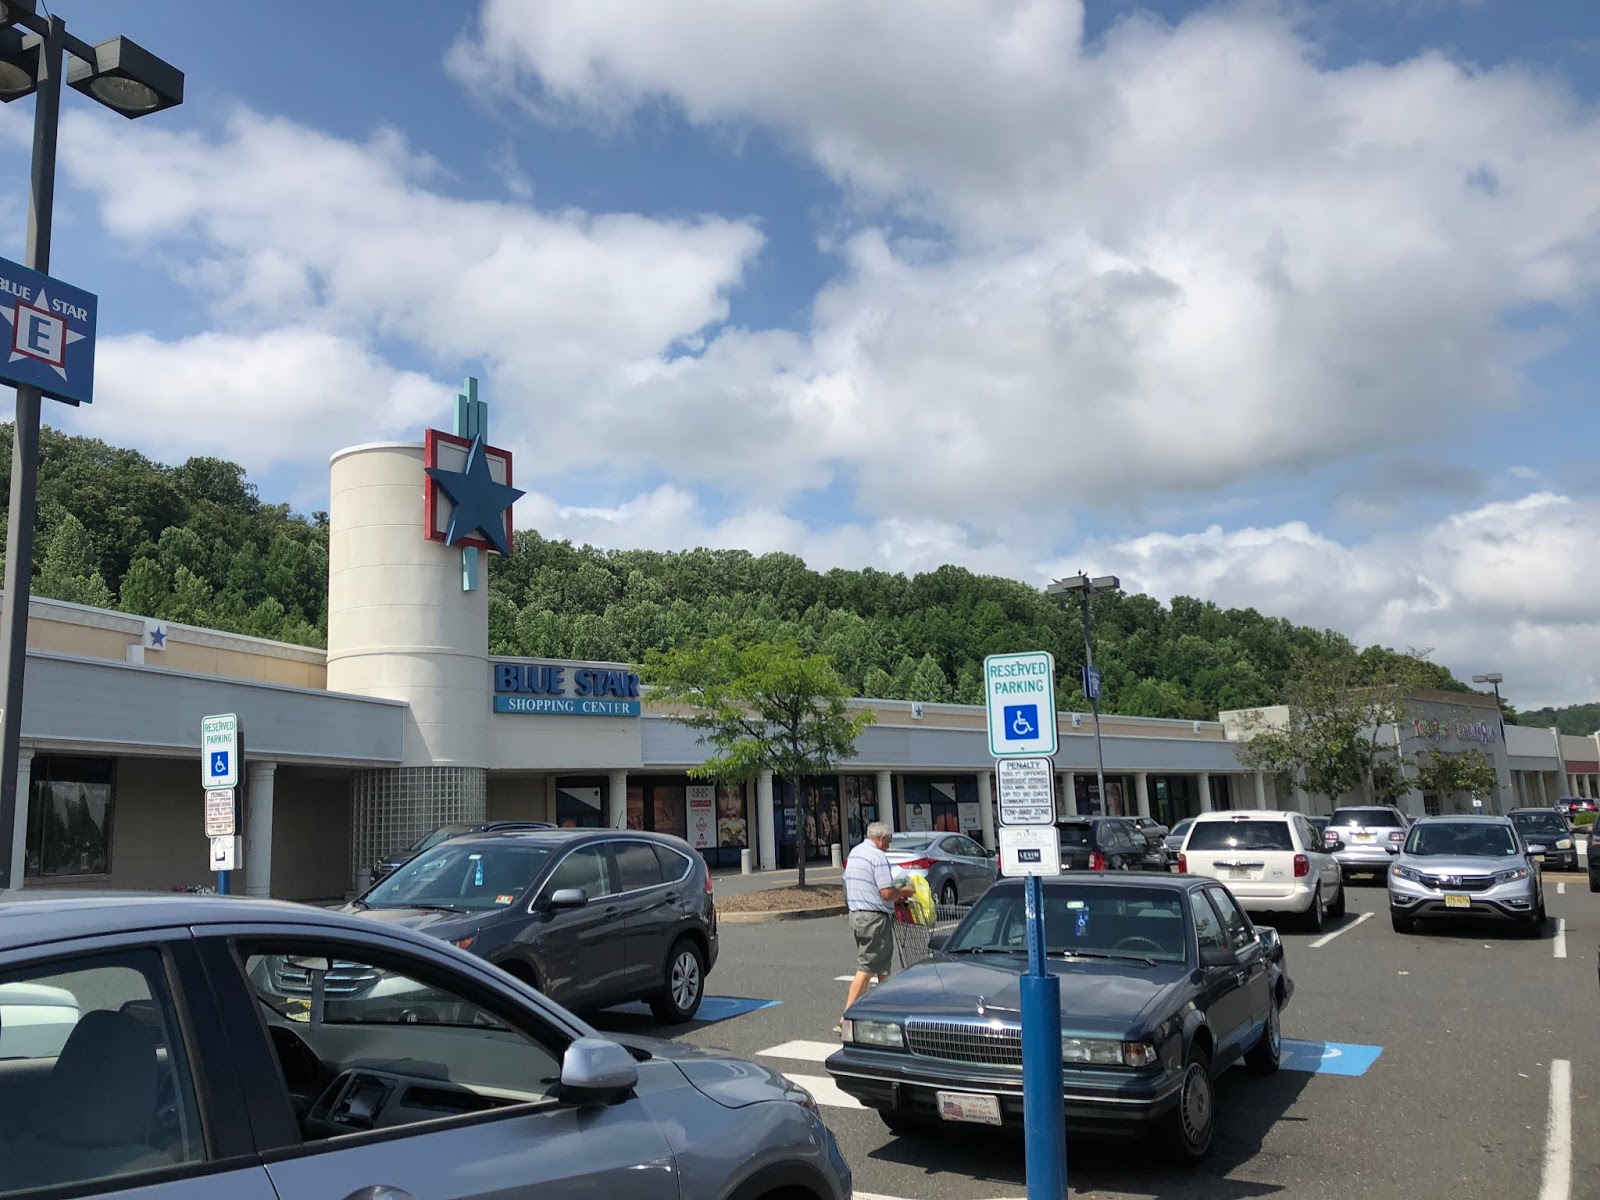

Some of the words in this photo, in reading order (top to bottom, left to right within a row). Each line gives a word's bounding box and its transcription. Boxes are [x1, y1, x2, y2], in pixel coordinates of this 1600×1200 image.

[52, 298, 88, 322] STAR
[27, 314, 51, 355] E
[990, 662, 1046, 678] RESERVED
[494, 663, 565, 694] BLUE
[574, 669, 640, 698] STAR
[995, 680, 1043, 695] PARKING
[508, 698, 574, 712] SHOPPING
[582, 701, 630, 713] CENTER
[204, 721, 233, 733] RESERVED
[206, 734, 232, 745] PARKING
[1006, 761, 1040, 770] PENALTY
[1004, 808, 1032, 816] TOW-AWAY
[1019, 851, 1040, 859] LEVIN
